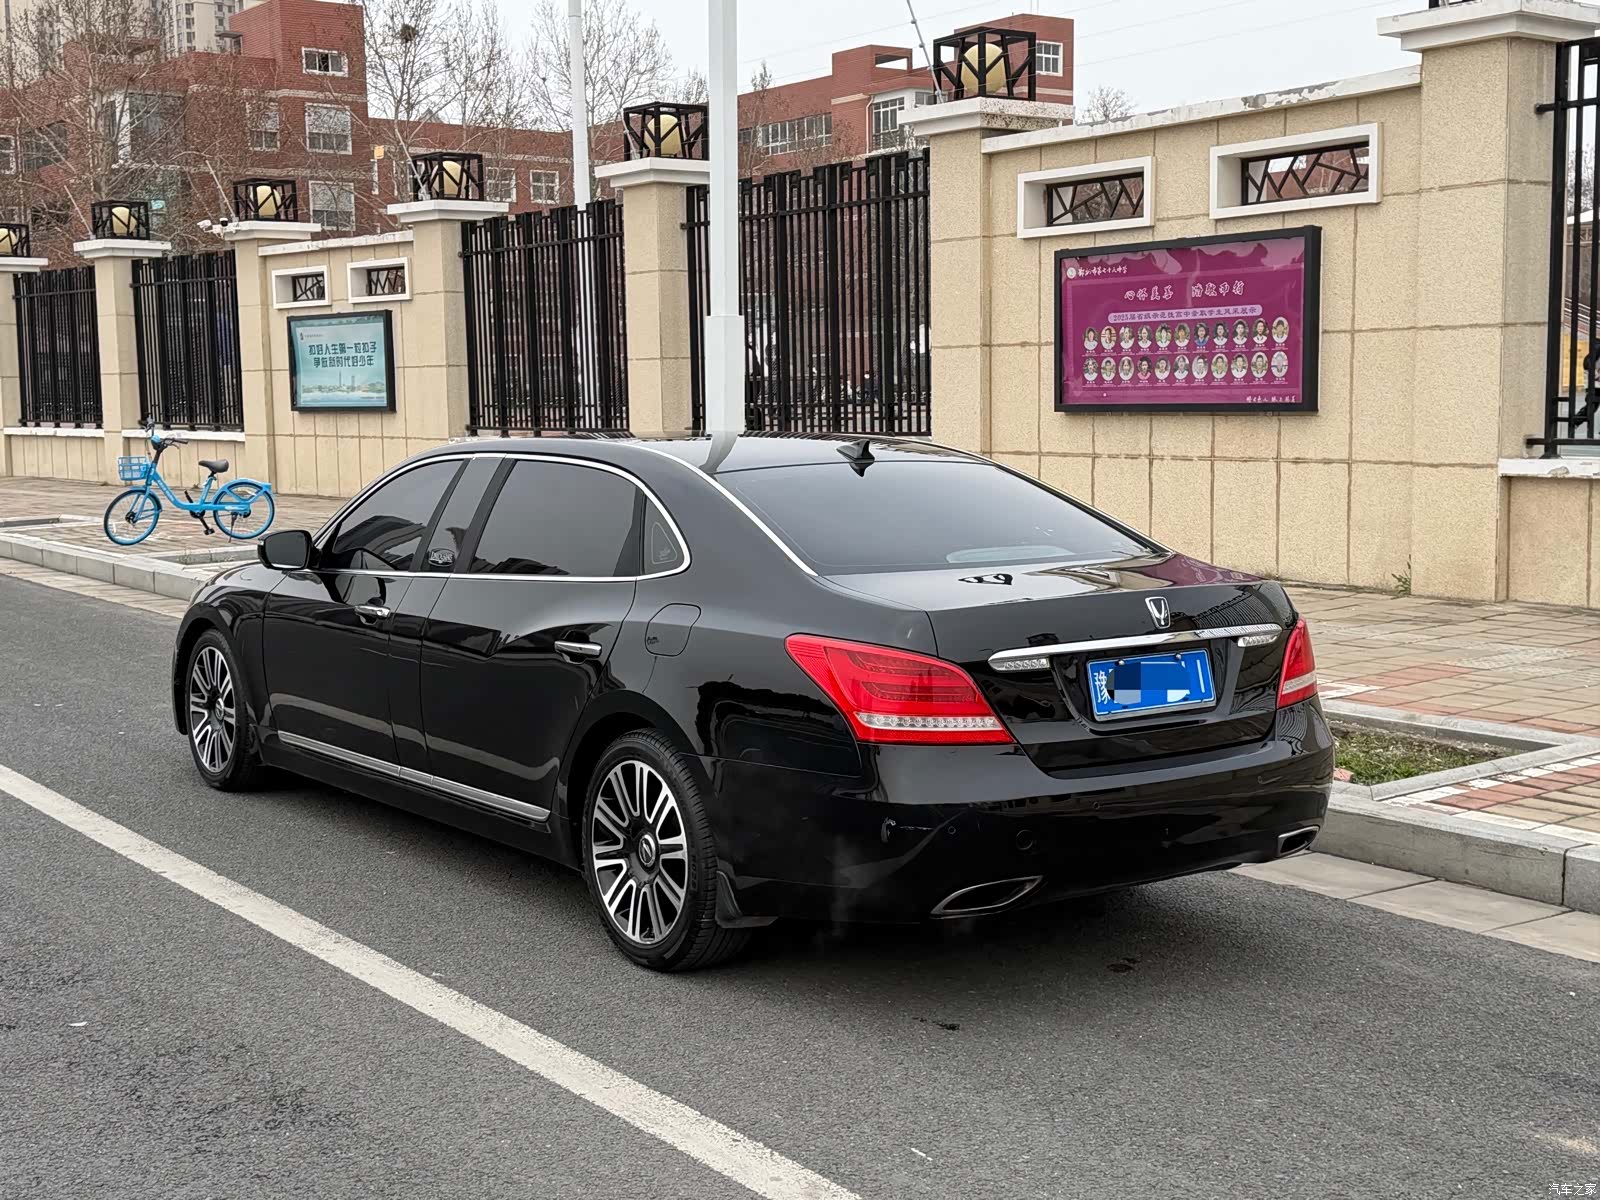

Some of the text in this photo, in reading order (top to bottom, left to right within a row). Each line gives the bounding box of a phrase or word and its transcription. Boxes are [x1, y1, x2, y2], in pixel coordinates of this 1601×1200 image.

[308, 341, 377, 355] 扣好人生第一粒扣子
[313, 355, 374, 368] 争做新时代好少年
